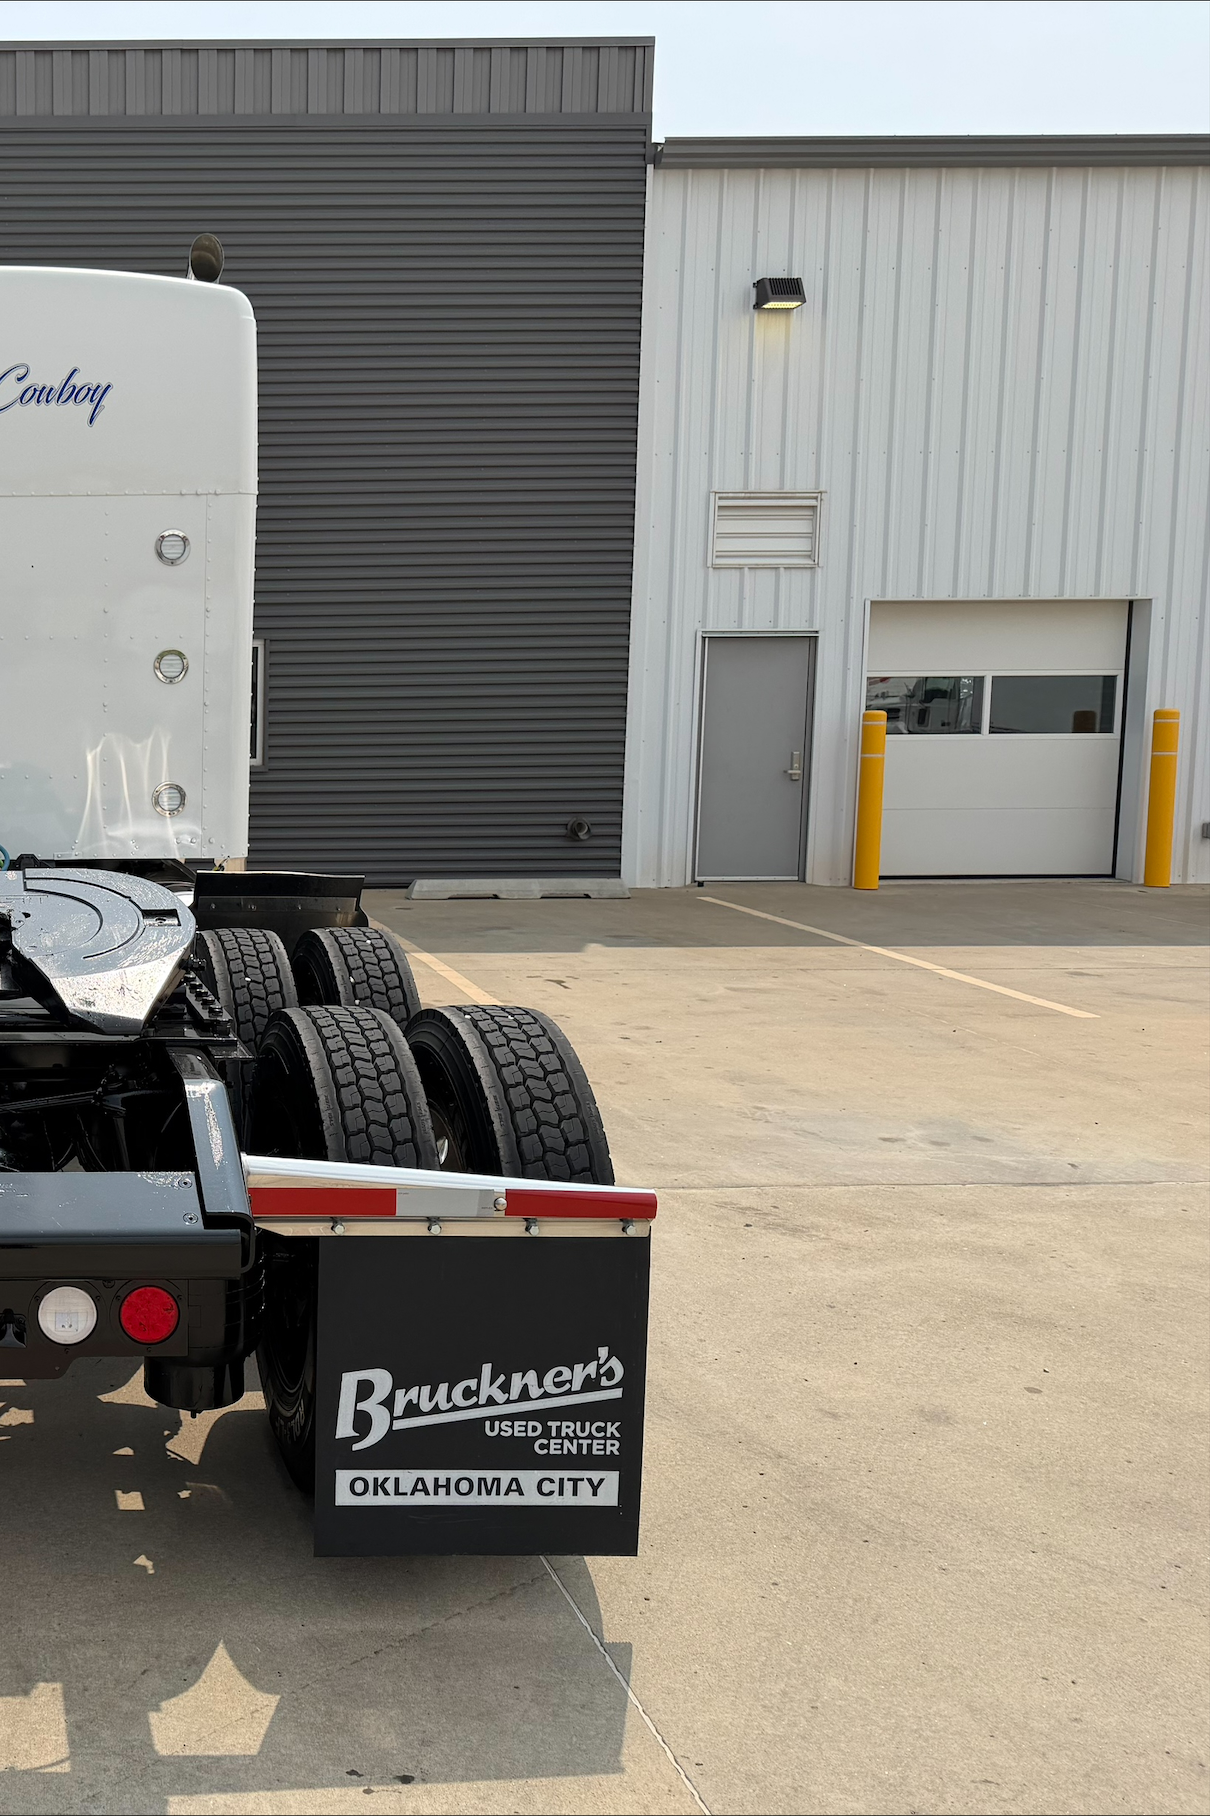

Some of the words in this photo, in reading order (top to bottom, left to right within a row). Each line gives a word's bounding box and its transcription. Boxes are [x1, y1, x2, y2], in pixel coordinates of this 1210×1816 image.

[335, 1346, 624, 1451] Bruckner's
[484, 1421, 541, 1438] USED
[547, 1421, 621, 1438] TRUCK
[533, 1439, 620, 1455] CENTER
[348, 1476, 525, 1497] OKLAHOMA
[536, 1476, 606, 1497] CITY
